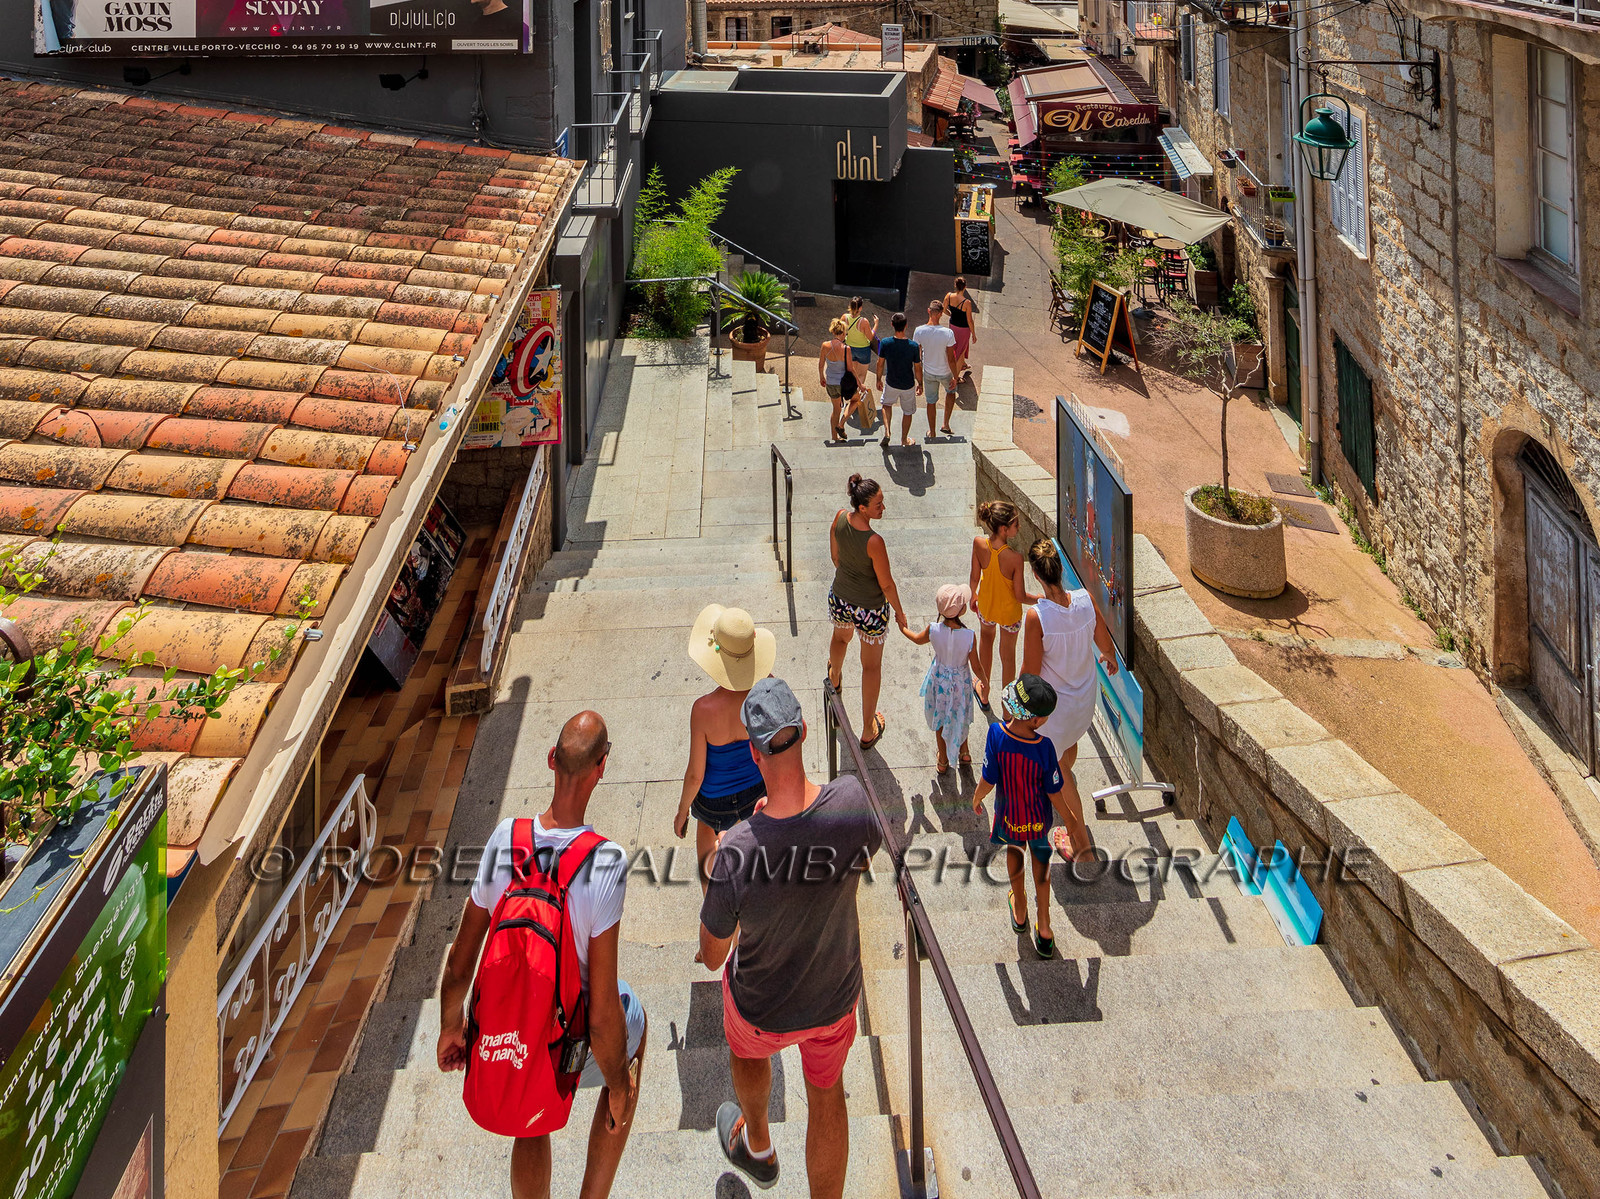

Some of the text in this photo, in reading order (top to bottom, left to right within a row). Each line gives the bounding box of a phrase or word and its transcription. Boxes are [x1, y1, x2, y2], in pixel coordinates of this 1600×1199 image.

[104, 2, 172, 15] GAVIN
[246, 0, 323, 15] SUNDAY
[103, 16, 172, 32] MOSS
[962, 36, 993, 46] OTHEO
[1075, 103, 1123, 113] Restaurant
[1098, 110, 1151, 128] Caseddu
[65, 966, 102, 1038] km
[59, 997, 106, 1088] min
[479, 1044, 523, 1070] de nanes
[51, 1029, 109, 1142] kcal.
[35, 1157, 61, 1199] onc
